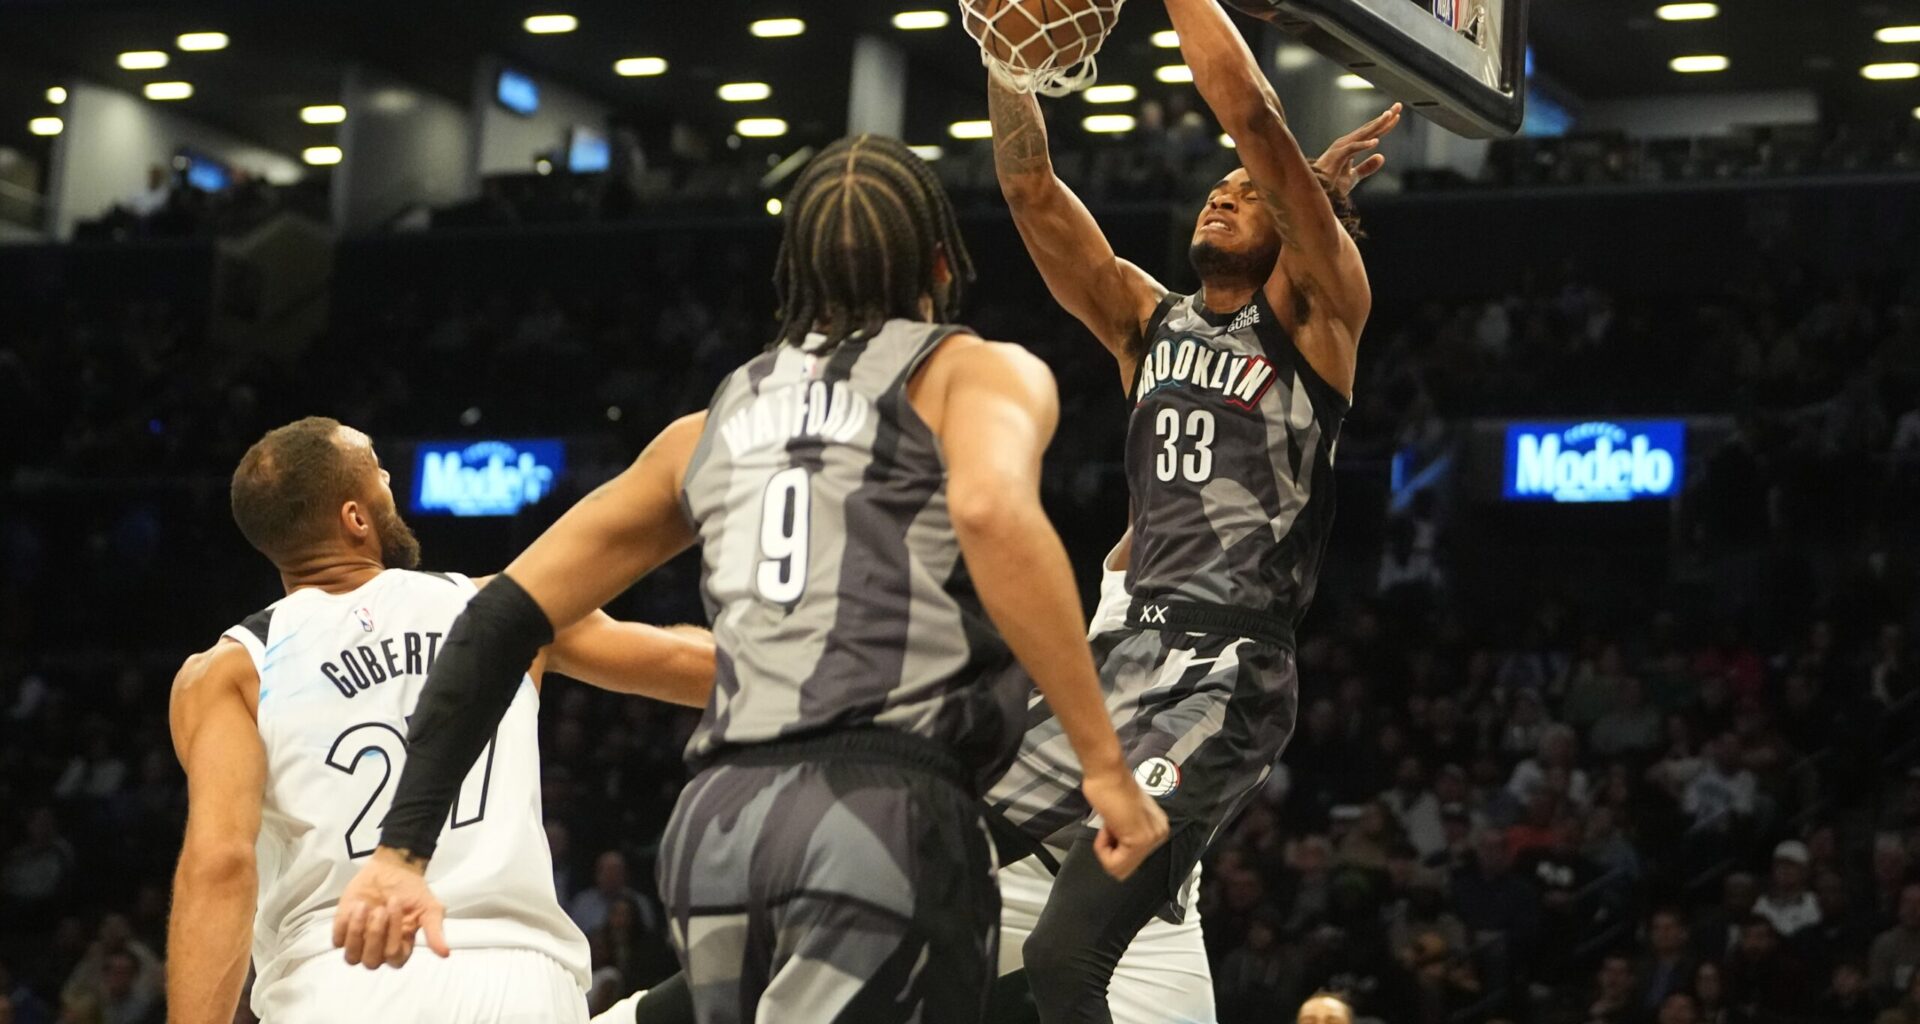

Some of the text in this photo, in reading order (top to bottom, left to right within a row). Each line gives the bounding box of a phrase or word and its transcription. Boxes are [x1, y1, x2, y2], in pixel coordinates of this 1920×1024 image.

[1228, 313, 1260, 332] GUIDE
[1233, 305, 1258, 323] OUR
[721, 380, 868, 457] WATFORD
[1155, 407, 1216, 483] 33
[1516, 432, 1674, 494] Modelo
[756, 467, 809, 603] 9
[320, 632, 442, 699] GOBERT
[1145, 762, 1167, 788] B
